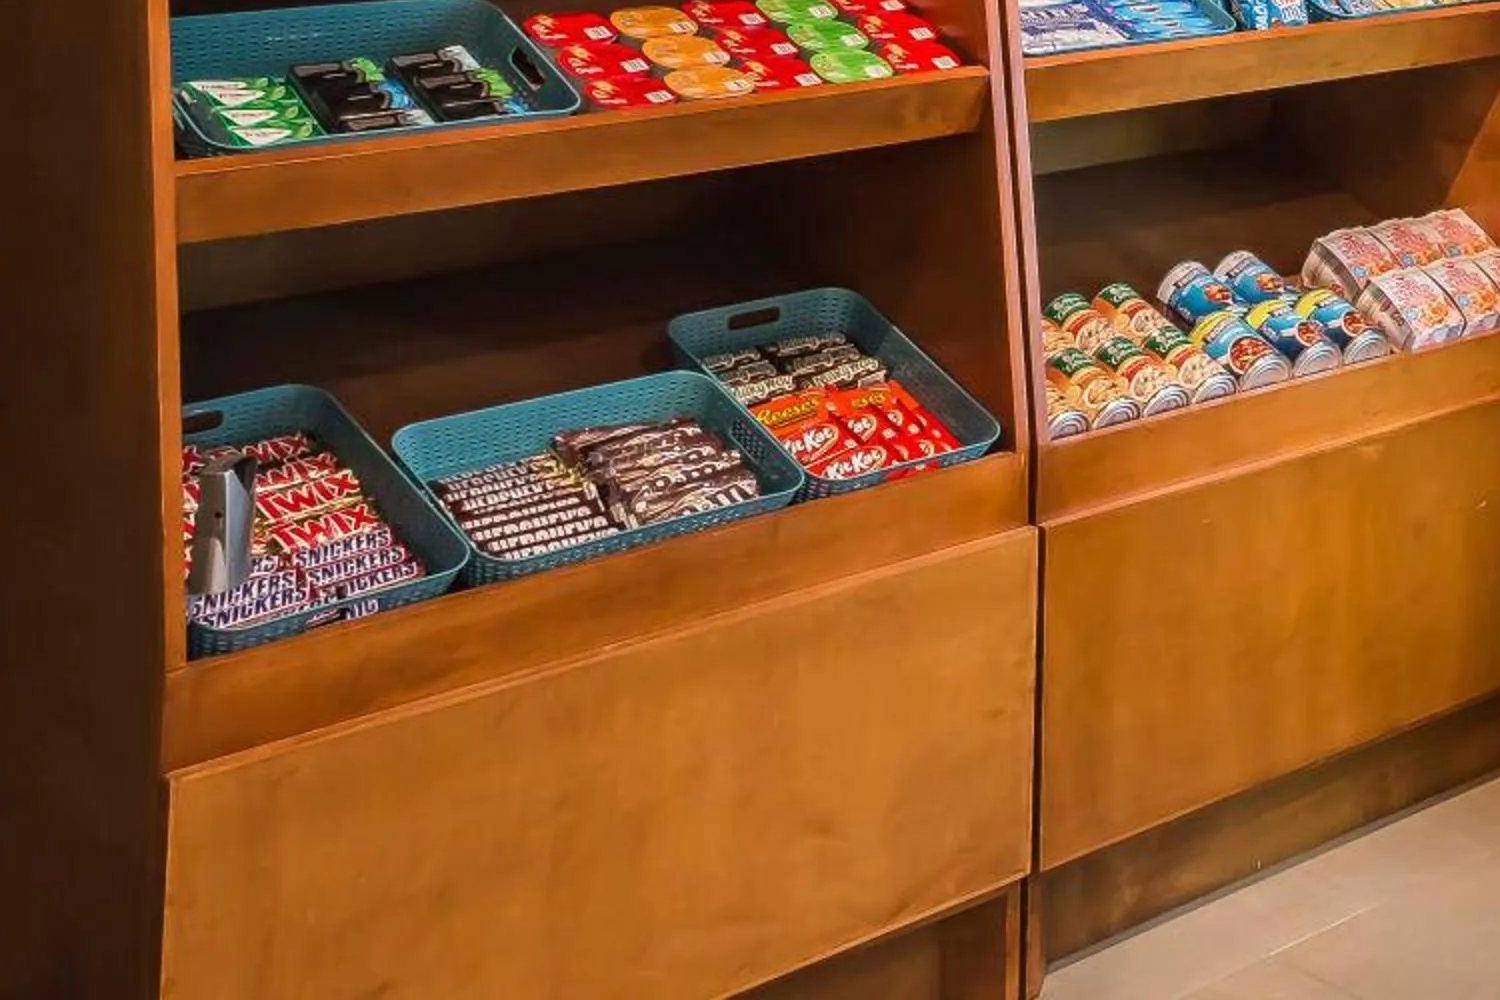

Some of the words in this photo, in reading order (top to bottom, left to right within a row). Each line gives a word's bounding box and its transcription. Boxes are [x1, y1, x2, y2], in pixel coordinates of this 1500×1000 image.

[256, 469, 361, 521] TWIX
[266, 503, 379, 550] TWIX
[293, 526, 390, 568] SNICKERS
[309, 547, 404, 585] SNICKERS
